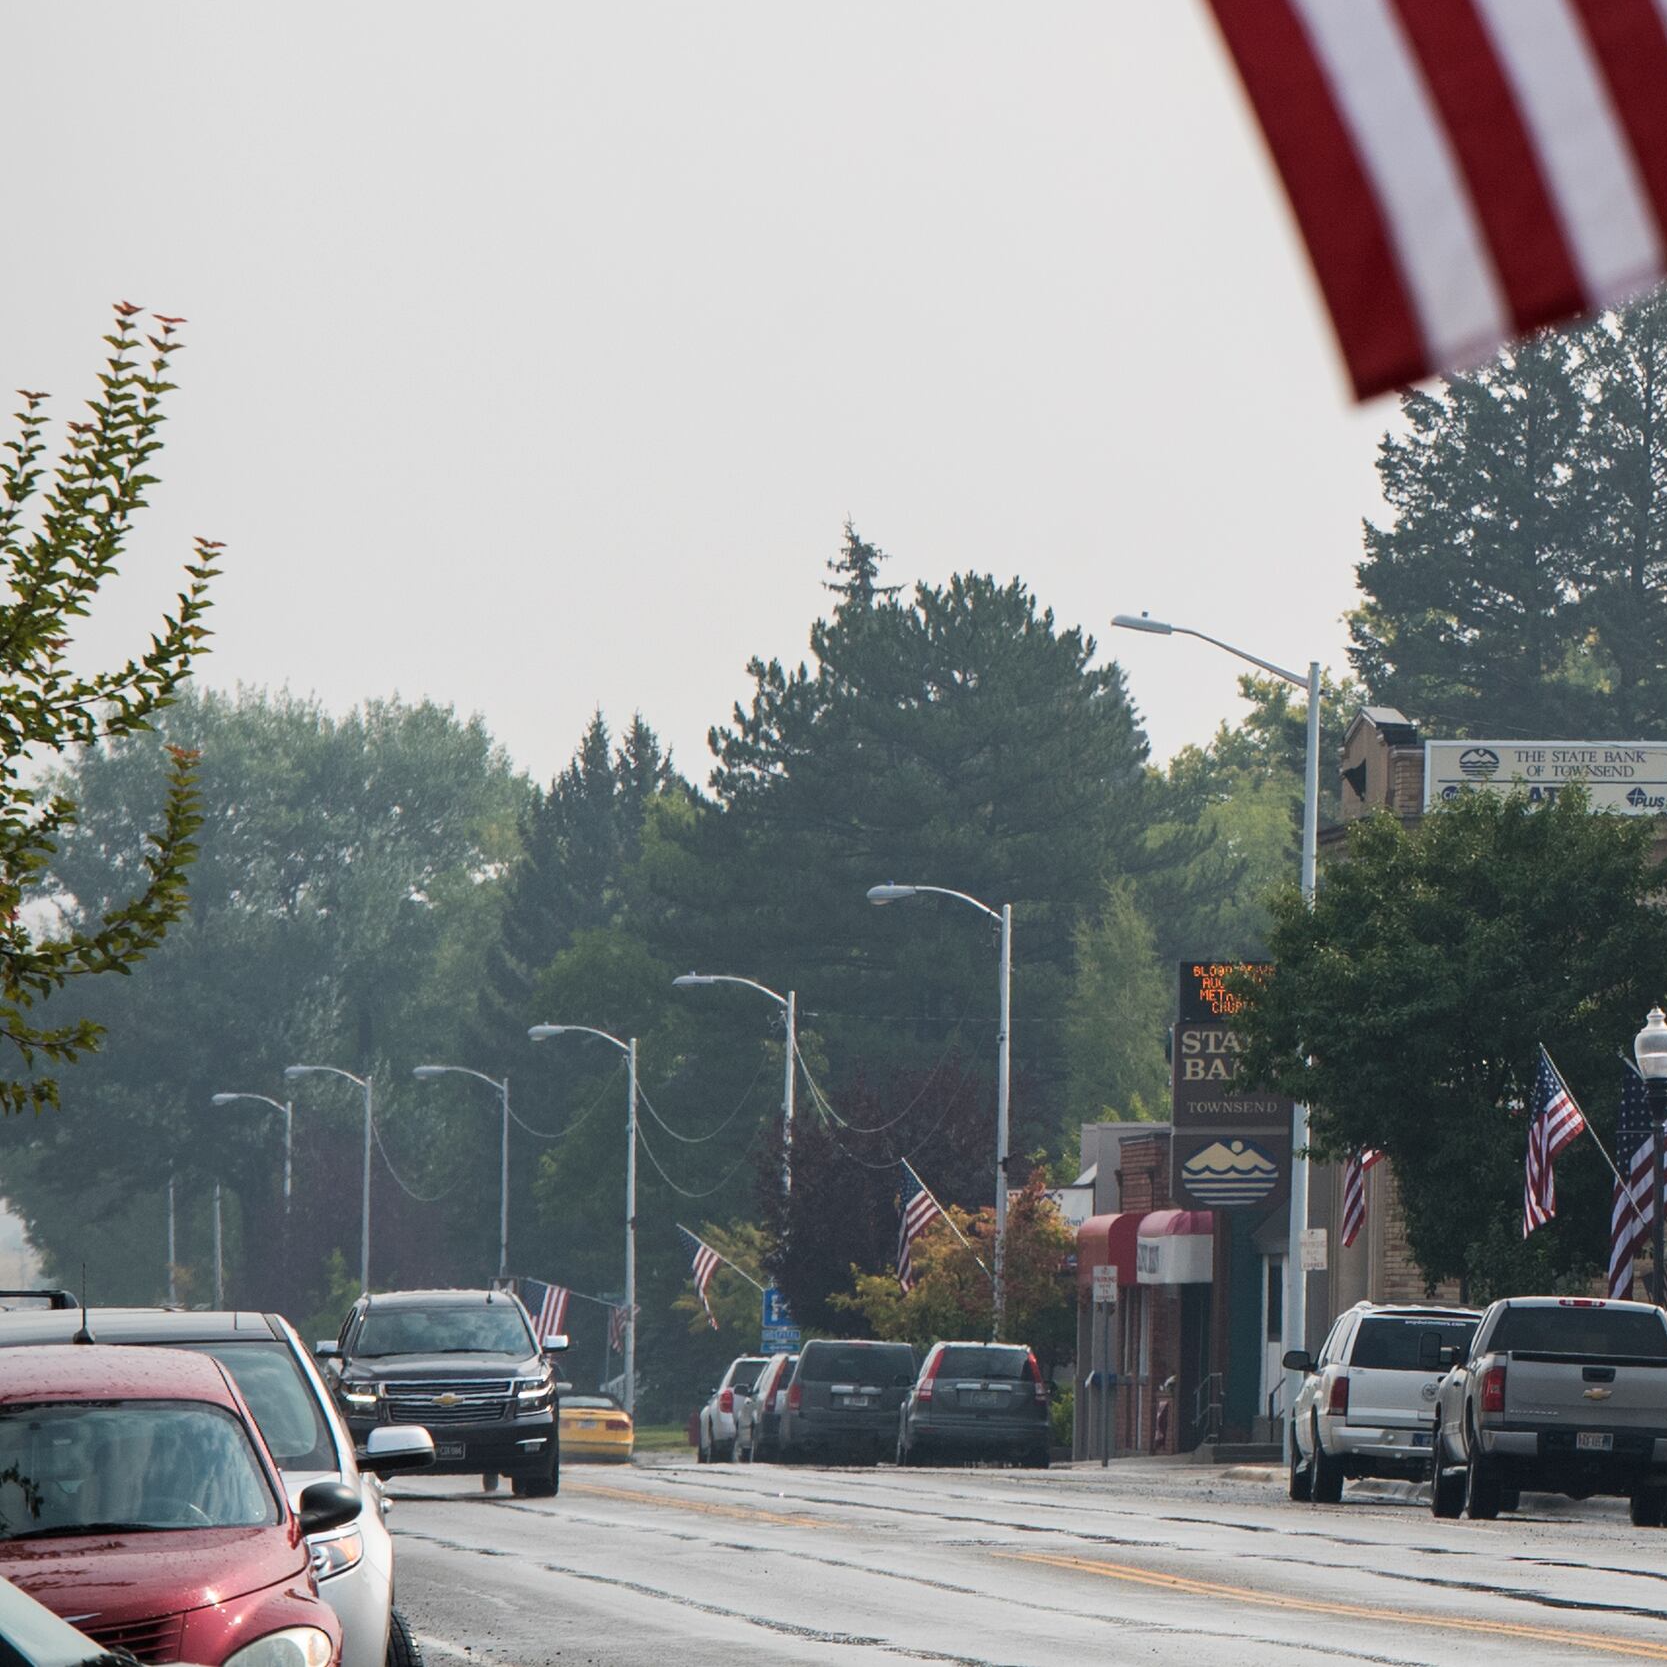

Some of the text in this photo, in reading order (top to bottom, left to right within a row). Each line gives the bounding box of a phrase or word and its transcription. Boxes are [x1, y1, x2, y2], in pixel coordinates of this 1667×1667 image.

[1514, 750, 1647, 763] THE STATE BANK
[1526, 765, 1635, 777] OF TOWNSEND
[1635, 796, 1665, 808] PLUS
[1187, 1101, 1278, 1114] TOWNSEND
